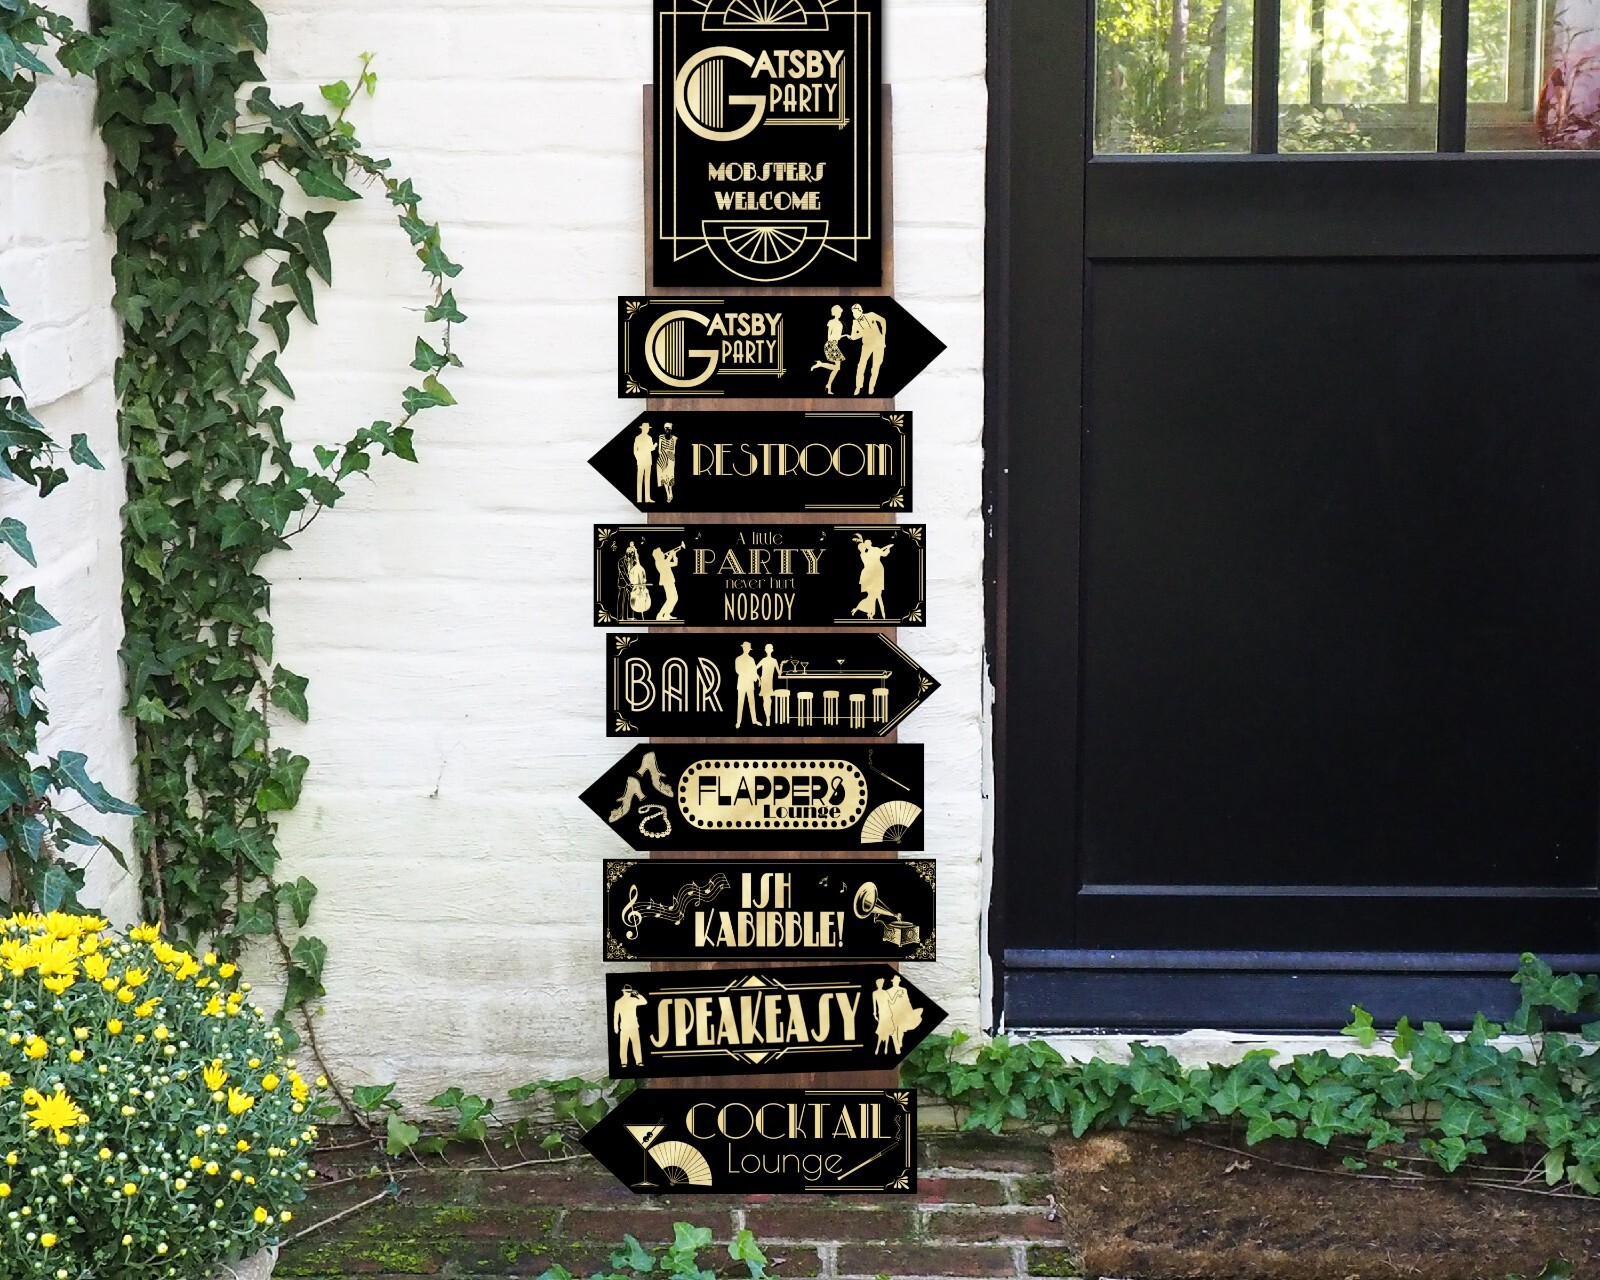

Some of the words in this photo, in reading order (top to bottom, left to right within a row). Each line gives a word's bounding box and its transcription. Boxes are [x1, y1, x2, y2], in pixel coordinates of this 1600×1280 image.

[770, 84, 837, 112] PARTY
[708, 162, 826, 182] MOBSTERS
[714, 191, 821, 210] WELCOME
[722, 340, 776, 363] PARTY
[691, 443, 893, 477] RESTROOM
[736, 532, 745, 545] A
[752, 532, 783, 545] little
[692, 548, 827, 575] PARTY
[725, 579, 766, 589] never
[770, 576, 796, 589] hurt
[724, 592, 796, 621] NOBODY
[625, 657, 723, 712] BAR
[698, 775, 846, 806] FLAPPERS
[763, 804, 841, 819] Lounge
[741, 872, 792, 908] ISH
[694, 908, 846, 947] KABIBBLE!
[650, 990, 861, 1048] SPEAKEASY
[685, 1102, 892, 1139] COCKTAIL
[728, 1142, 843, 1181] Lounge
